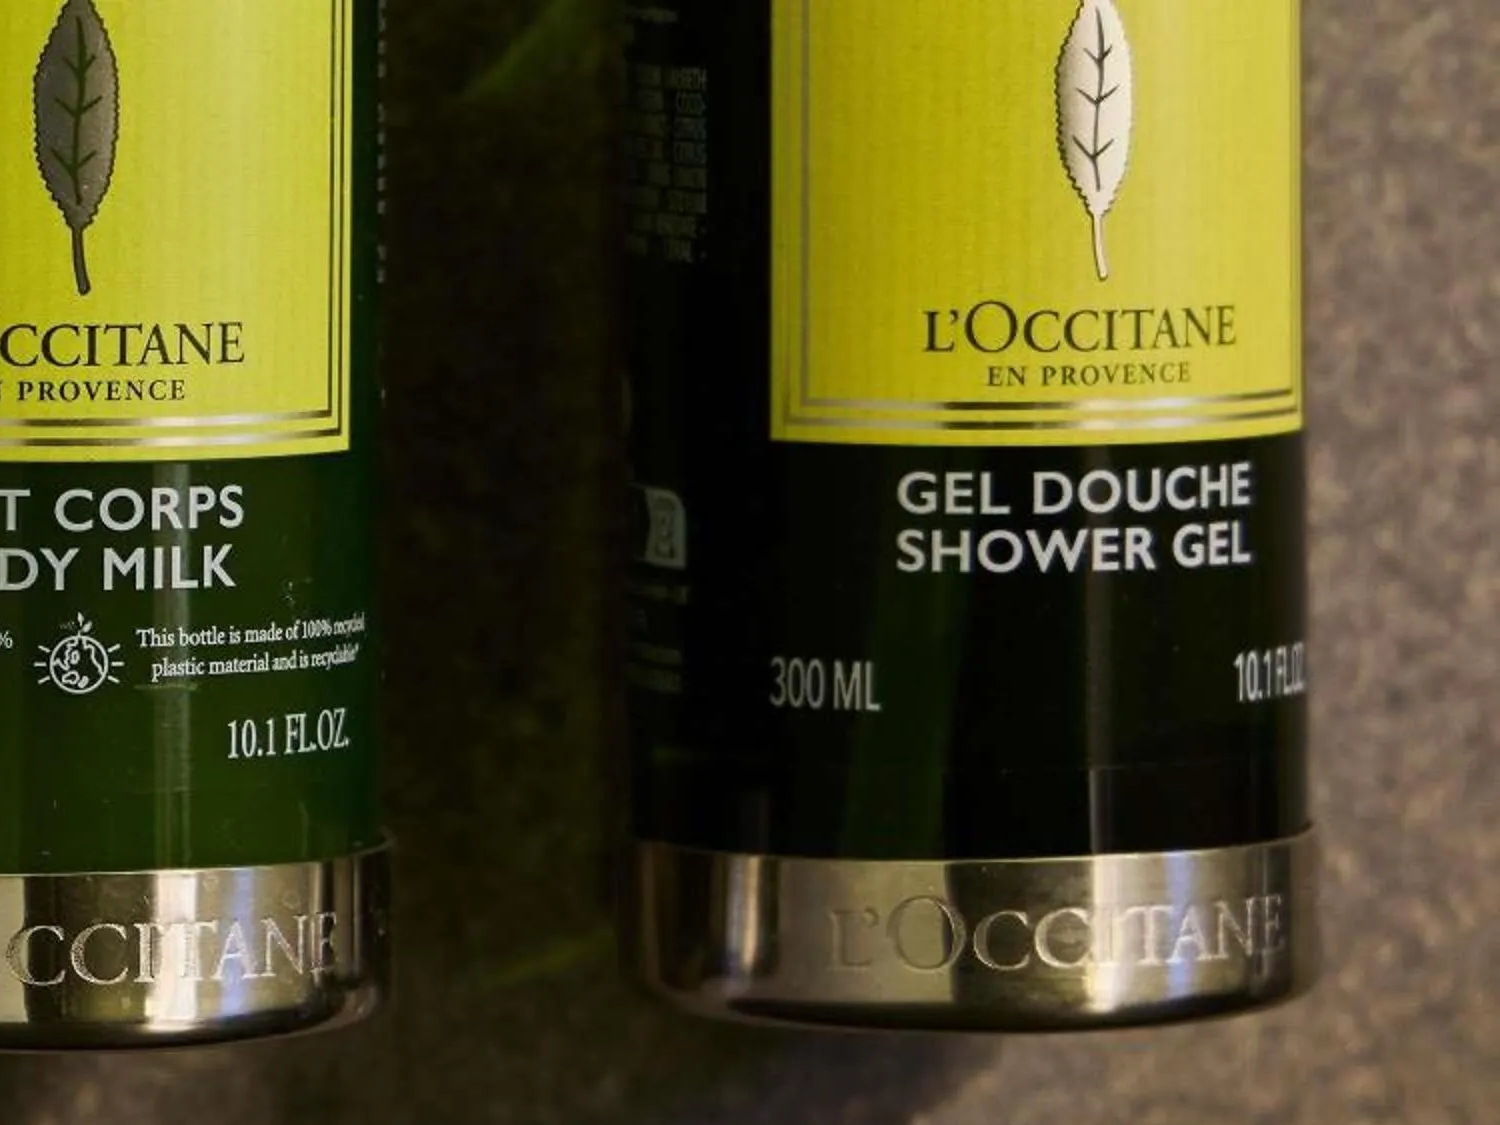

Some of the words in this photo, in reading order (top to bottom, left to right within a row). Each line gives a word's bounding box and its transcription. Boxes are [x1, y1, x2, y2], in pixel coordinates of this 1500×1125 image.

[923, 300, 1236, 353] L'OCCITANE
[18, 378, 186, 401] PROVENCE
[987, 366, 1026, 387] EN
[1042, 361, 1191, 386] PROVENCE
[55, 485, 244, 531] CORPS
[898, 471, 1011, 515] GEL
[1033, 462, 1251, 513] DOUCHE
[103, 544, 236, 590] MILK
[896, 528, 1156, 573] SHOWER
[1173, 521, 1251, 567] GEL
[136, 628, 174, 648] This
[180, 626, 225, 646] bottle
[229, 625, 241, 643] is
[245, 621, 283, 643] made
[285, 619, 301, 640] of
[302, 619, 332, 640] 100%
[152, 658, 204, 682] plastic
[209, 653, 269, 675] material
[272, 650, 297, 671] and
[299, 651, 309, 667] is
[770, 657, 825, 708] 300
[833, 661, 881, 711] ML
[1233, 650, 1271, 703] 10.1
[227, 718, 276, 759] 10.1
